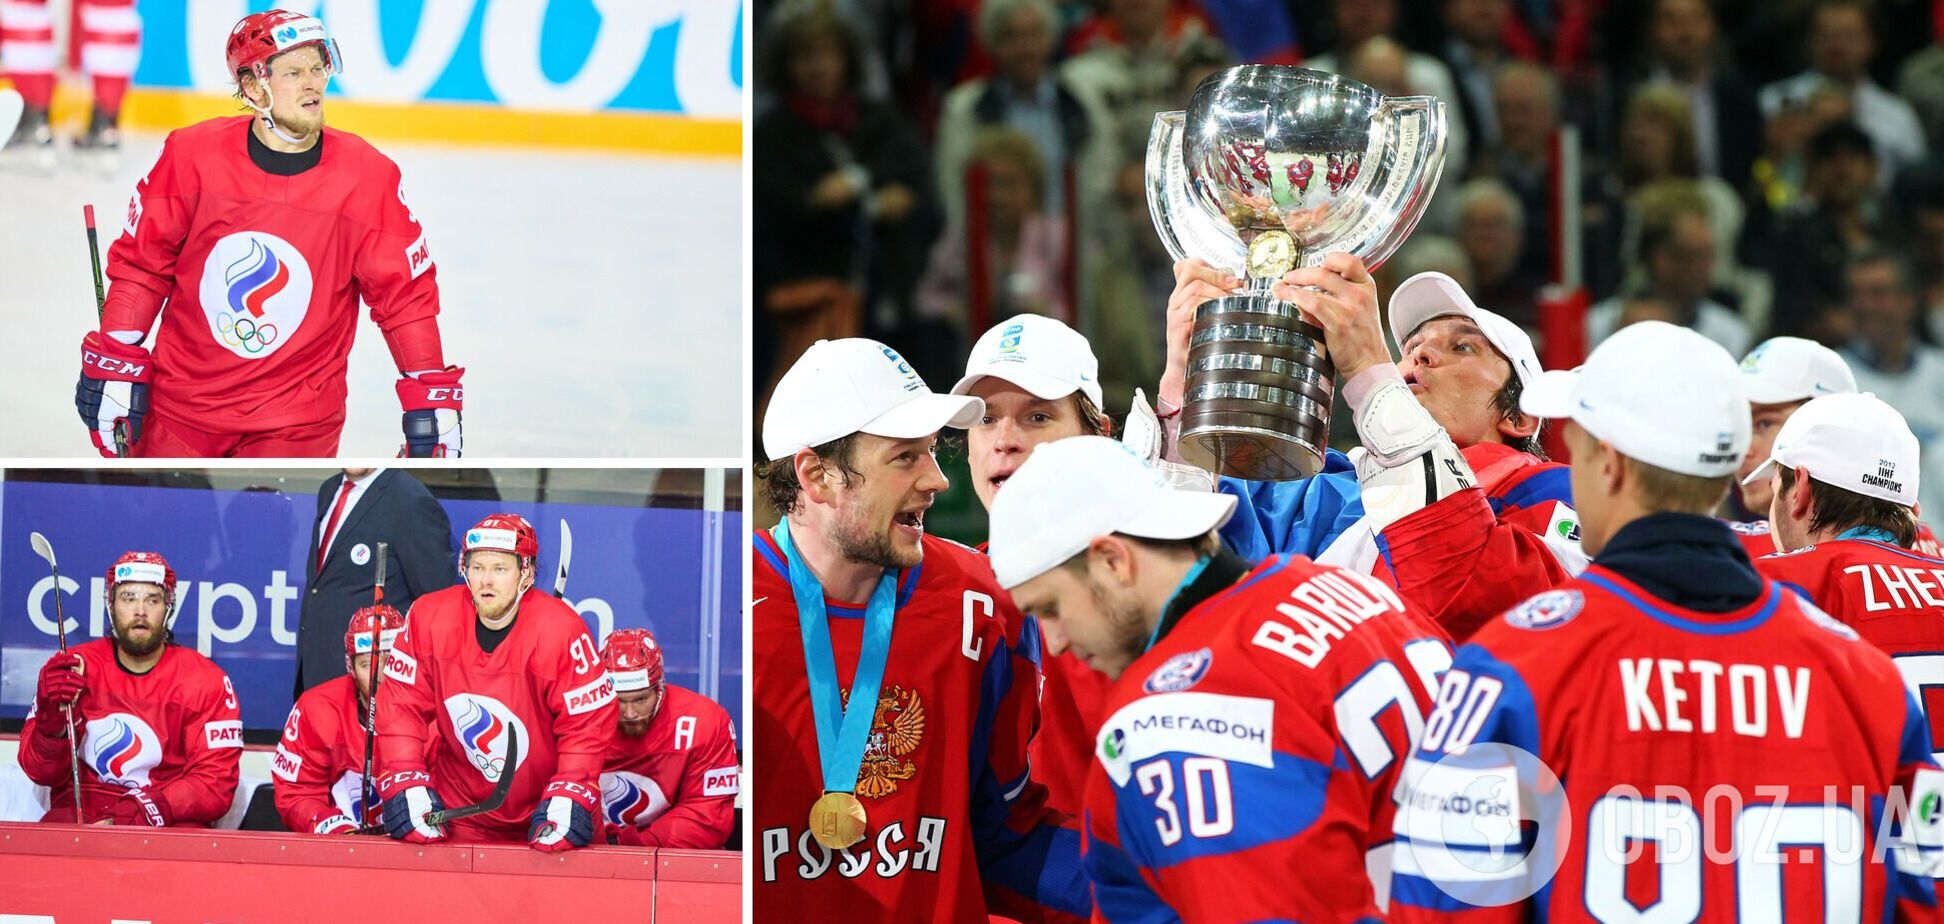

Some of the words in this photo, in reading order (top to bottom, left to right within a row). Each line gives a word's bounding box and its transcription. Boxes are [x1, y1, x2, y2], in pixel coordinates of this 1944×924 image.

[411, 237, 430, 270] PA
[83, 350, 145, 377] CCM
[1878, 467, 1895, 479] IIHF
[1879, 459, 1896, 469] 2012
[1862, 473, 1903, 493] CHAMPIONS
[1843, 563, 1944, 612] ZHE
[962, 589, 993, 662] C
[569, 633, 601, 675] 91
[1420, 669, 1502, 757] 80
[1618, 657, 1811, 739] KETOV
[284, 701, 301, 742] 9
[674, 715, 697, 750] A
[1133, 715, 1266, 744] МЕГАФОН
[381, 771, 430, 791] CCM
[546, 781, 597, 804] CCM
[1136, 757, 1235, 847] 30
